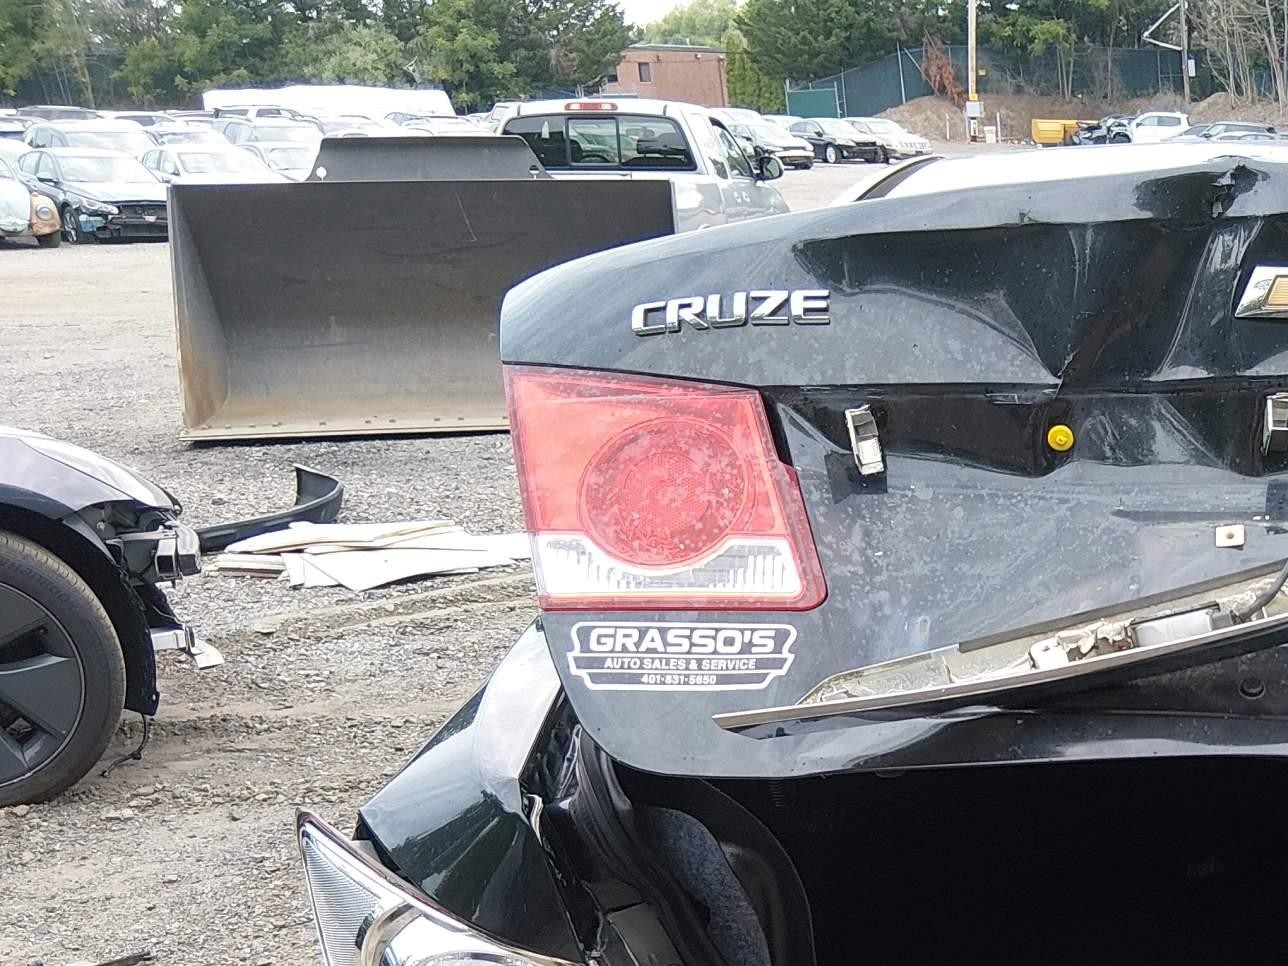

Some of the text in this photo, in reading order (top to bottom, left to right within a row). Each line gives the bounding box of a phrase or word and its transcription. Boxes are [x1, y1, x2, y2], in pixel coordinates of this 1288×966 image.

[631, 289, 831, 335] CRUZE
[589, 627, 776, 654] GRASSO'S
[604, 657, 757, 671] AUTO SALES & SERVICE
